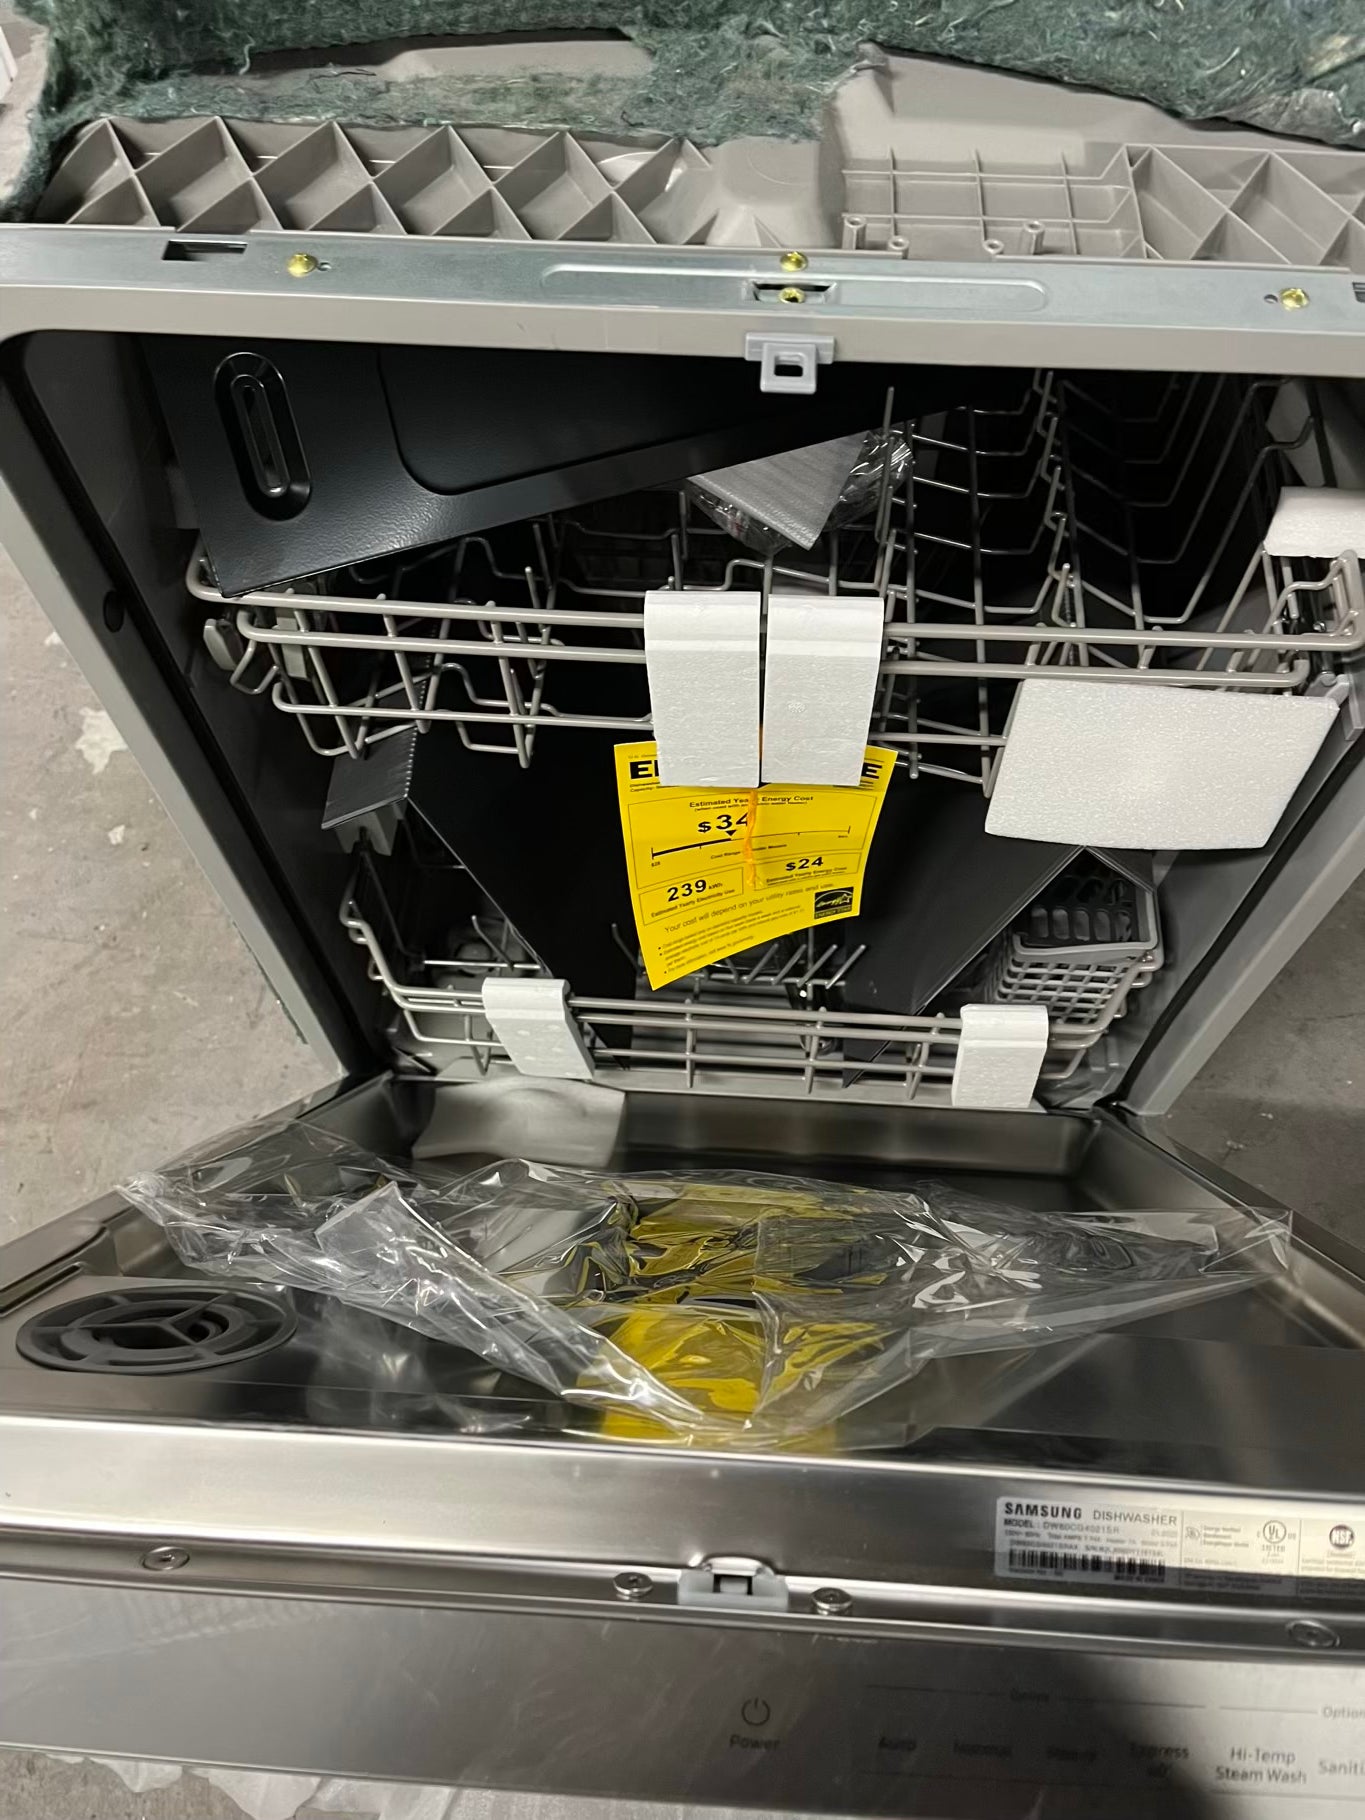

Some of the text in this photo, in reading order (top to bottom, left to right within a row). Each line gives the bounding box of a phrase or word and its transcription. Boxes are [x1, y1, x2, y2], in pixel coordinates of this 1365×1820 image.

[689, 799, 731, 807] Estimated
[786, 856, 824, 872] $24
[667, 879, 707, 903] 239
[665, 923, 681, 933] Your
[683, 916, 698, 928] cost
[699, 913, 710, 921] will
[711, 903, 738, 918] depend
[738, 901, 748, 909] on
[749, 897, 765, 908] your
[766, 890, 785, 901] utility
[805, 884, 820, 893] and
[1005, 1501, 1177, 1526] SAMSUNG DISHWASHER
[1004, 1518, 1034, 1529] MODEL
[1268, 1524, 1280, 1540] UL
[729, 1733, 781, 1751] Power
[1230, 1746, 1296, 1767] Hi-Temp
[1215, 1764, 1308, 1785] Steam Wash
